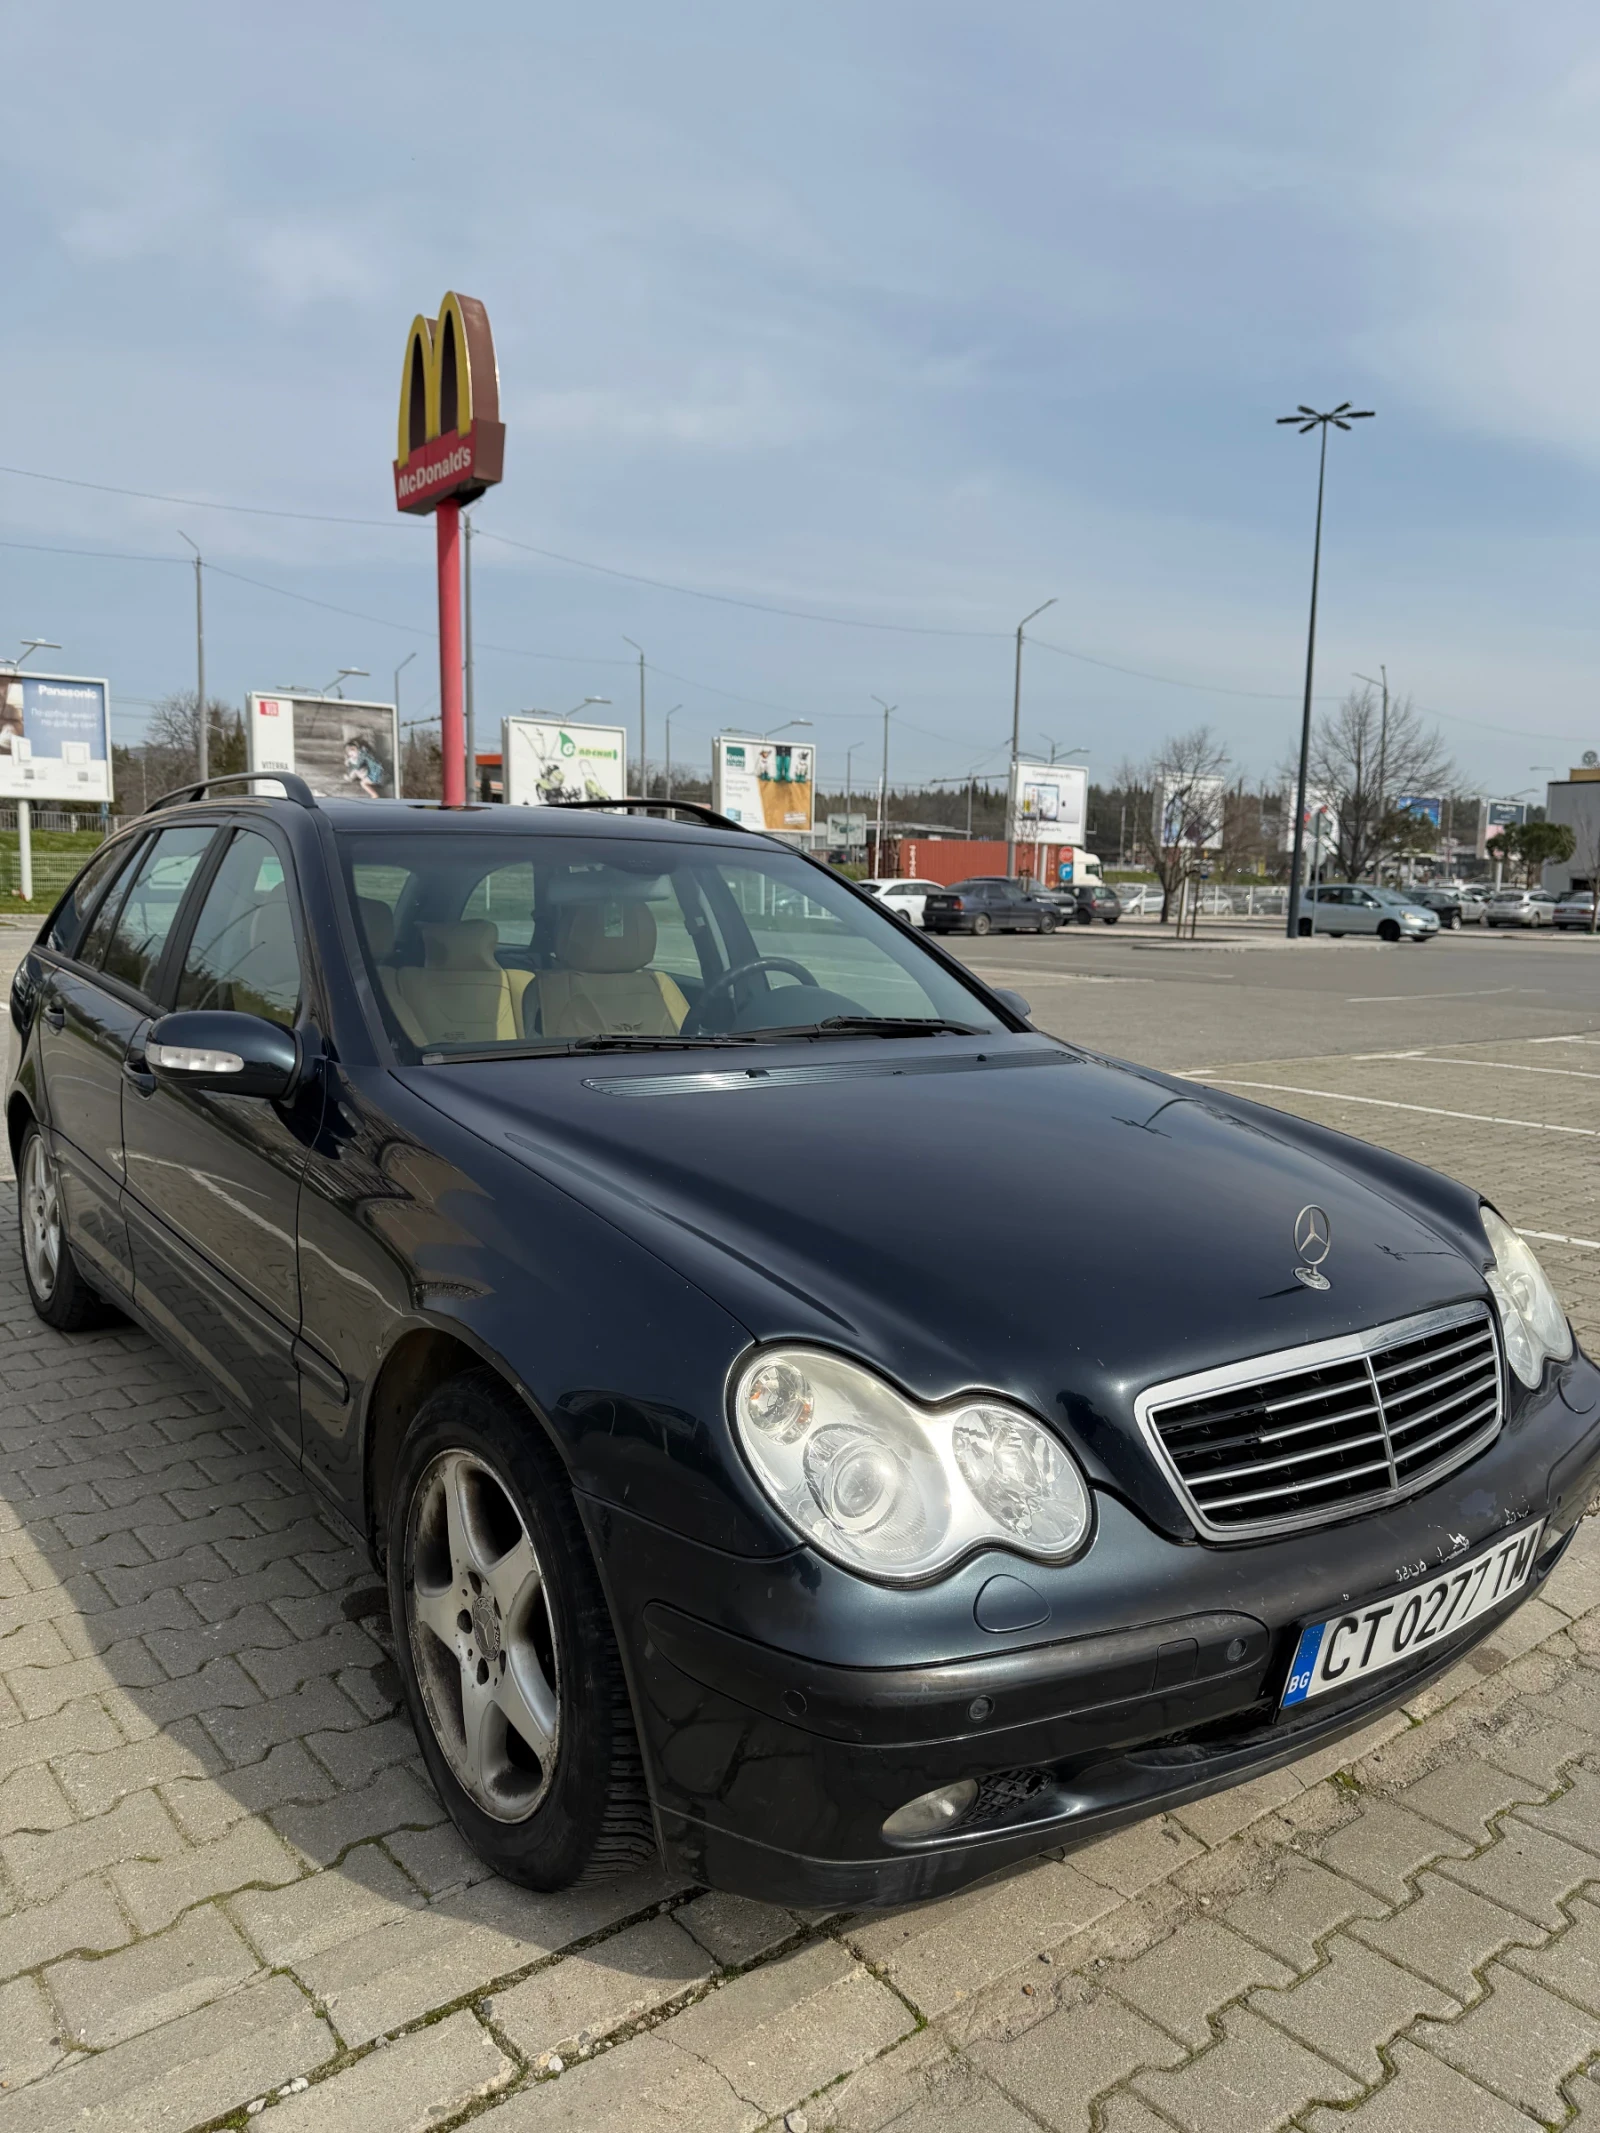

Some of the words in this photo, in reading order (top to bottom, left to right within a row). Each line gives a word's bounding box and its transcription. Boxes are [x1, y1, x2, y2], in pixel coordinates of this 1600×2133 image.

[398, 446, 471, 499] McDonald's
[38, 684, 97, 699] Panasonic
[1321, 1606, 1393, 1681] CT
[1393, 1557, 1492, 1653] 0277
[1491, 1528, 1539, 1599] TM
[1287, 1671, 1311, 1694] BG
